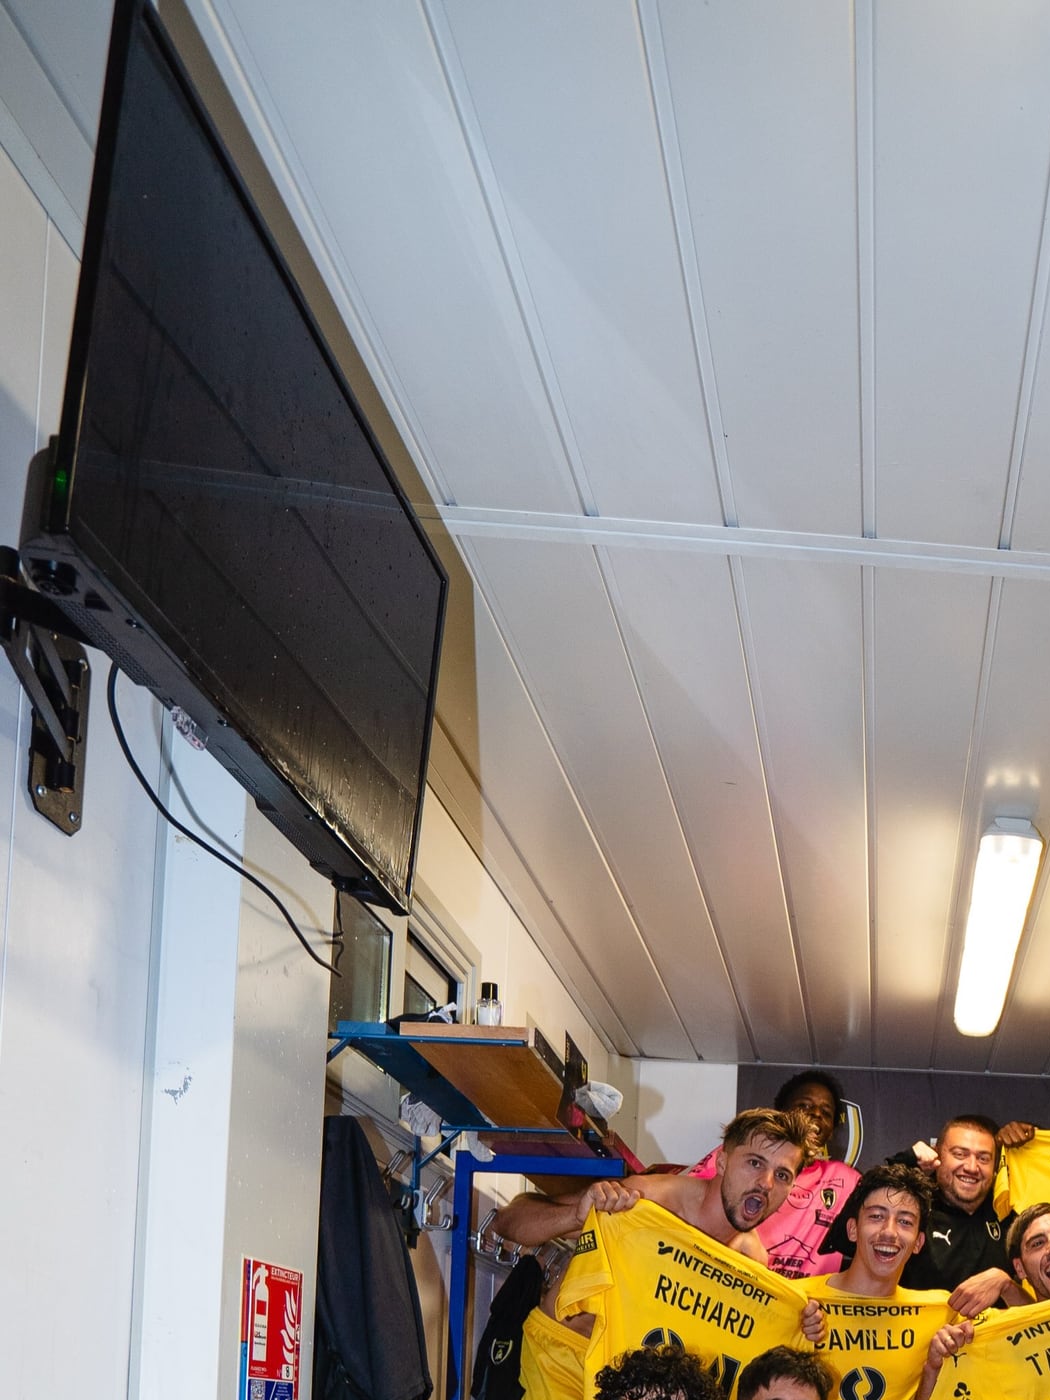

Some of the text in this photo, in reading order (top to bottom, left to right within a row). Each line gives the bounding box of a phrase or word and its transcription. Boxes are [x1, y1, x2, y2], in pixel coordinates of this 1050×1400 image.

[654, 1273, 755, 1340] RICHARD
[673, 1249, 776, 1307] INTERSPORT
[819, 1303, 922, 1317] NTERSPORT
